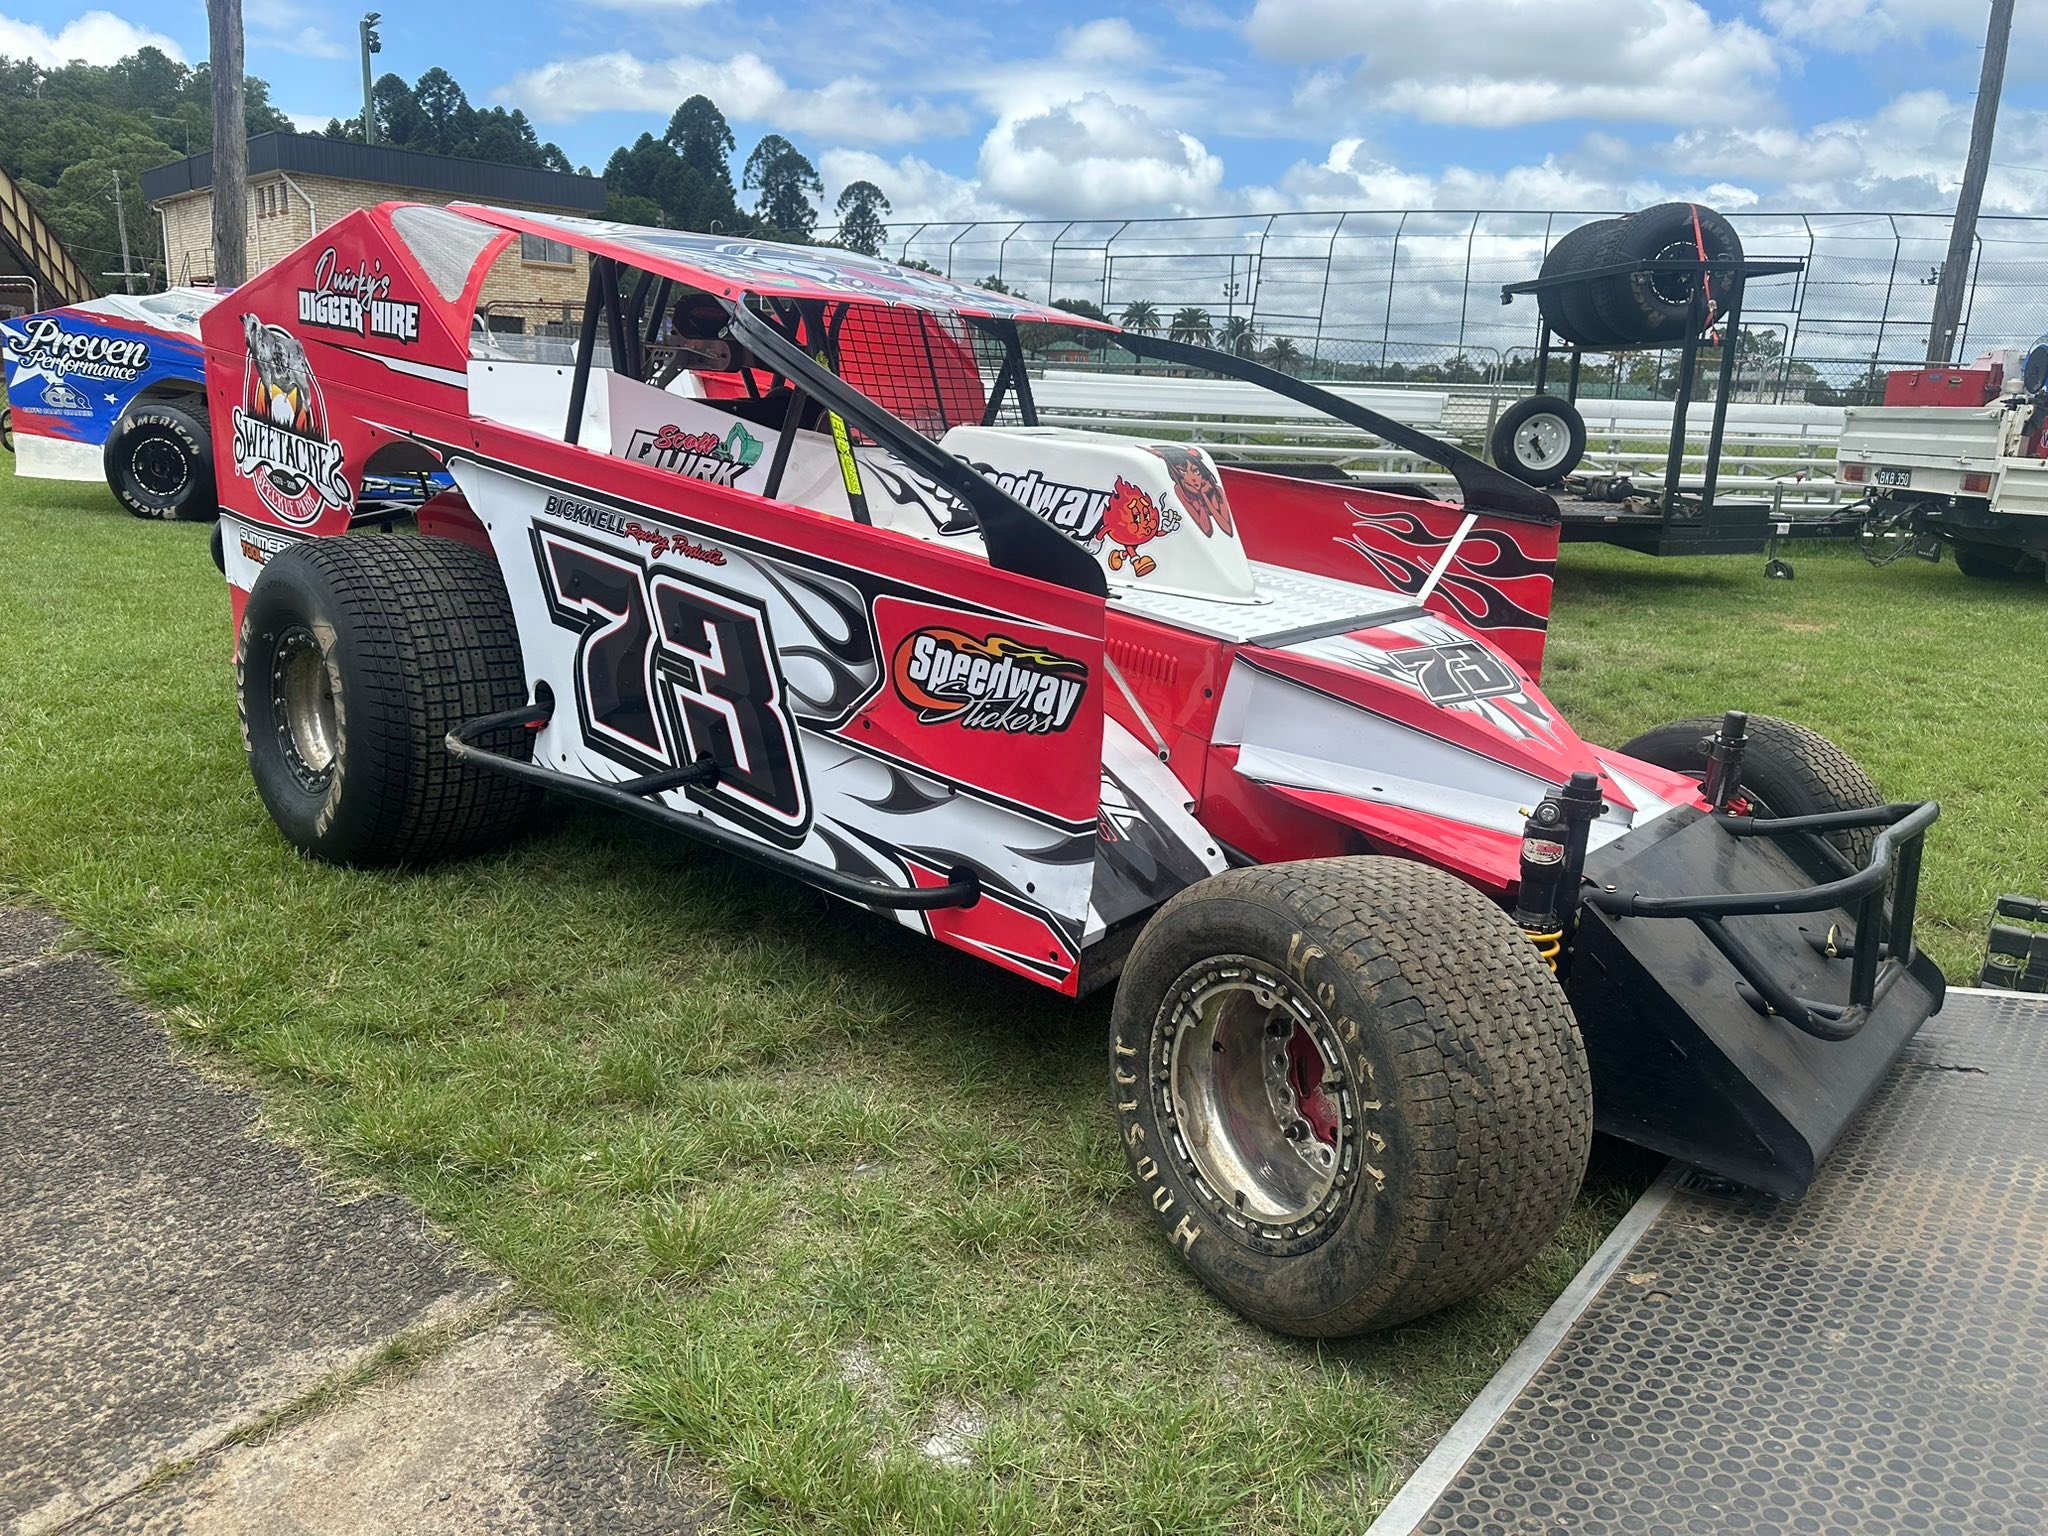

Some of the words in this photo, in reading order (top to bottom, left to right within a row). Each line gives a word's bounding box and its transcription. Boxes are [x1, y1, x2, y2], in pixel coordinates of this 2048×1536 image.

[315, 247, 391, 311] Quirky's
[298, 290, 364, 335] DIGGER
[371, 300, 419, 341] HIRE
[9, 318, 147, 368] Proven
[20, 348, 138, 382] Performance
[122, 414, 200, 456] AMERICAN
[233, 407, 352, 504] SWEETACRES
[654, 425, 720, 454] Scott
[122, 490, 177, 519] RACER
[257, 470, 296, 516] SPECKLE
[296, 490, 318, 517] PARK
[545, 494, 627, 538] BICKNELL
[625, 522, 671, 558] Racing
[671, 534, 727, 566] Products
[532, 518, 812, 848] 73
[908, 634, 1082, 727] Speedway
[1388, 640, 1520, 703] 73
[918, 679, 1055, 733] Stickers
